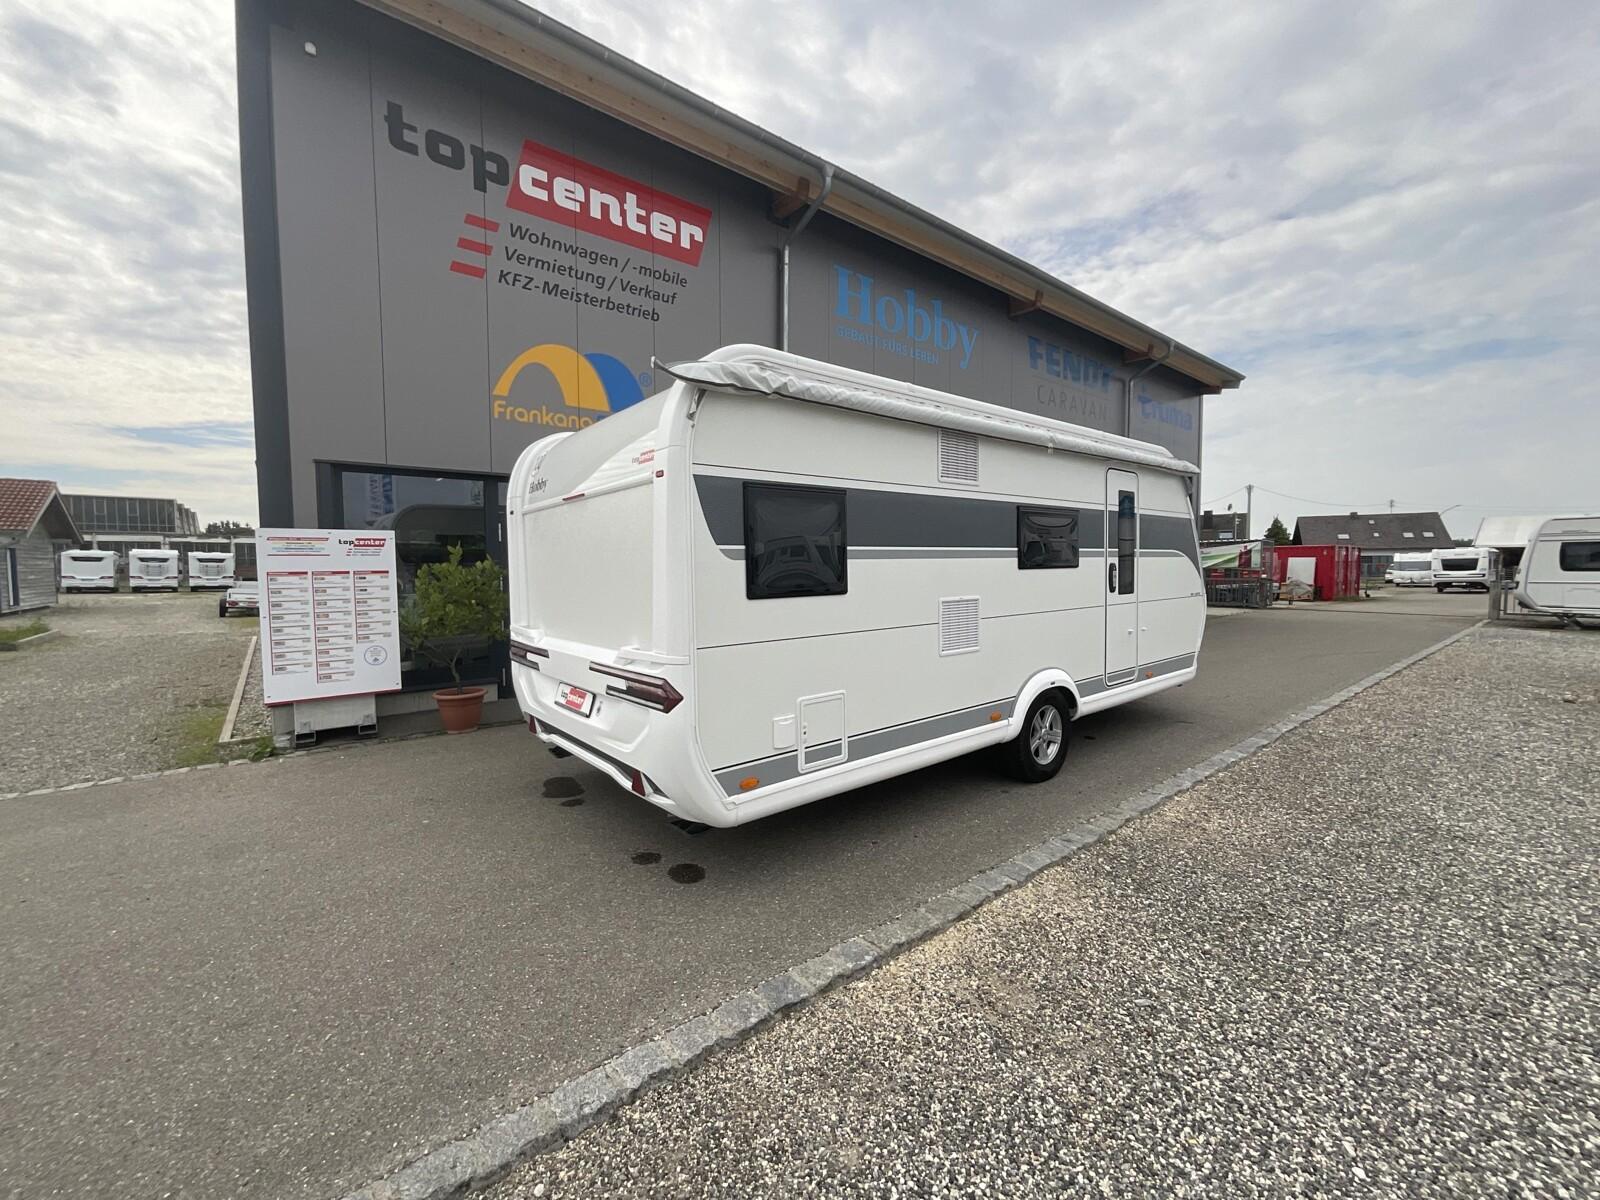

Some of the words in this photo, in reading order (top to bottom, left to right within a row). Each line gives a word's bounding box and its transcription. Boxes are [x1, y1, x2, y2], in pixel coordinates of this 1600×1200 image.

[498, 269, 660, 322] KFZ-Meisterbetrieb
[834, 264, 980, 369] Hobby
[1027, 335, 1116, 394] FENDT
[1037, 384, 1112, 421] CARAVAN
